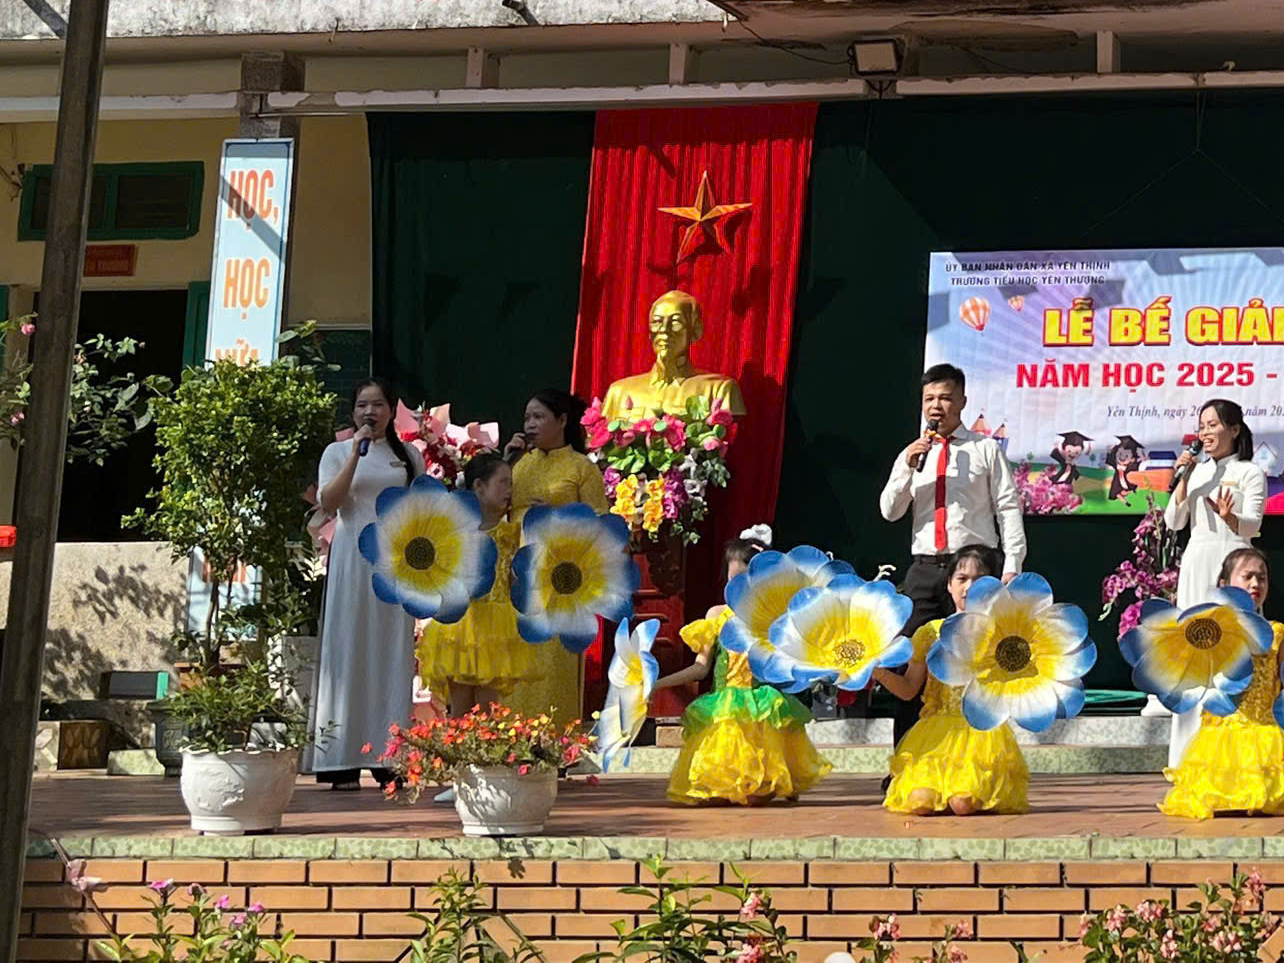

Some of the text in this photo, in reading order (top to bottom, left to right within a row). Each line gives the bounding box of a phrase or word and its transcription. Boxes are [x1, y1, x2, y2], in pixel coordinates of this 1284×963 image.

[227, 170, 279, 230] HỌC,
[961, 262, 982, 271] BAN
[223, 258, 271, 320] HỌC
[1043, 296, 1094, 347] LỄ
[1108, 296, 1172, 347] BẾ
[1016, 358, 1090, 388] NĂM
[1102, 362, 1165, 393] HỌC
[1176, 362, 1255, 387] 2025
[1107, 405, 1125, 417] Yên
[1129, 405, 1160, 420] Thịnh,
[1163, 405, 1187, 419] ngày
[1245, 406, 1267, 417] năm
